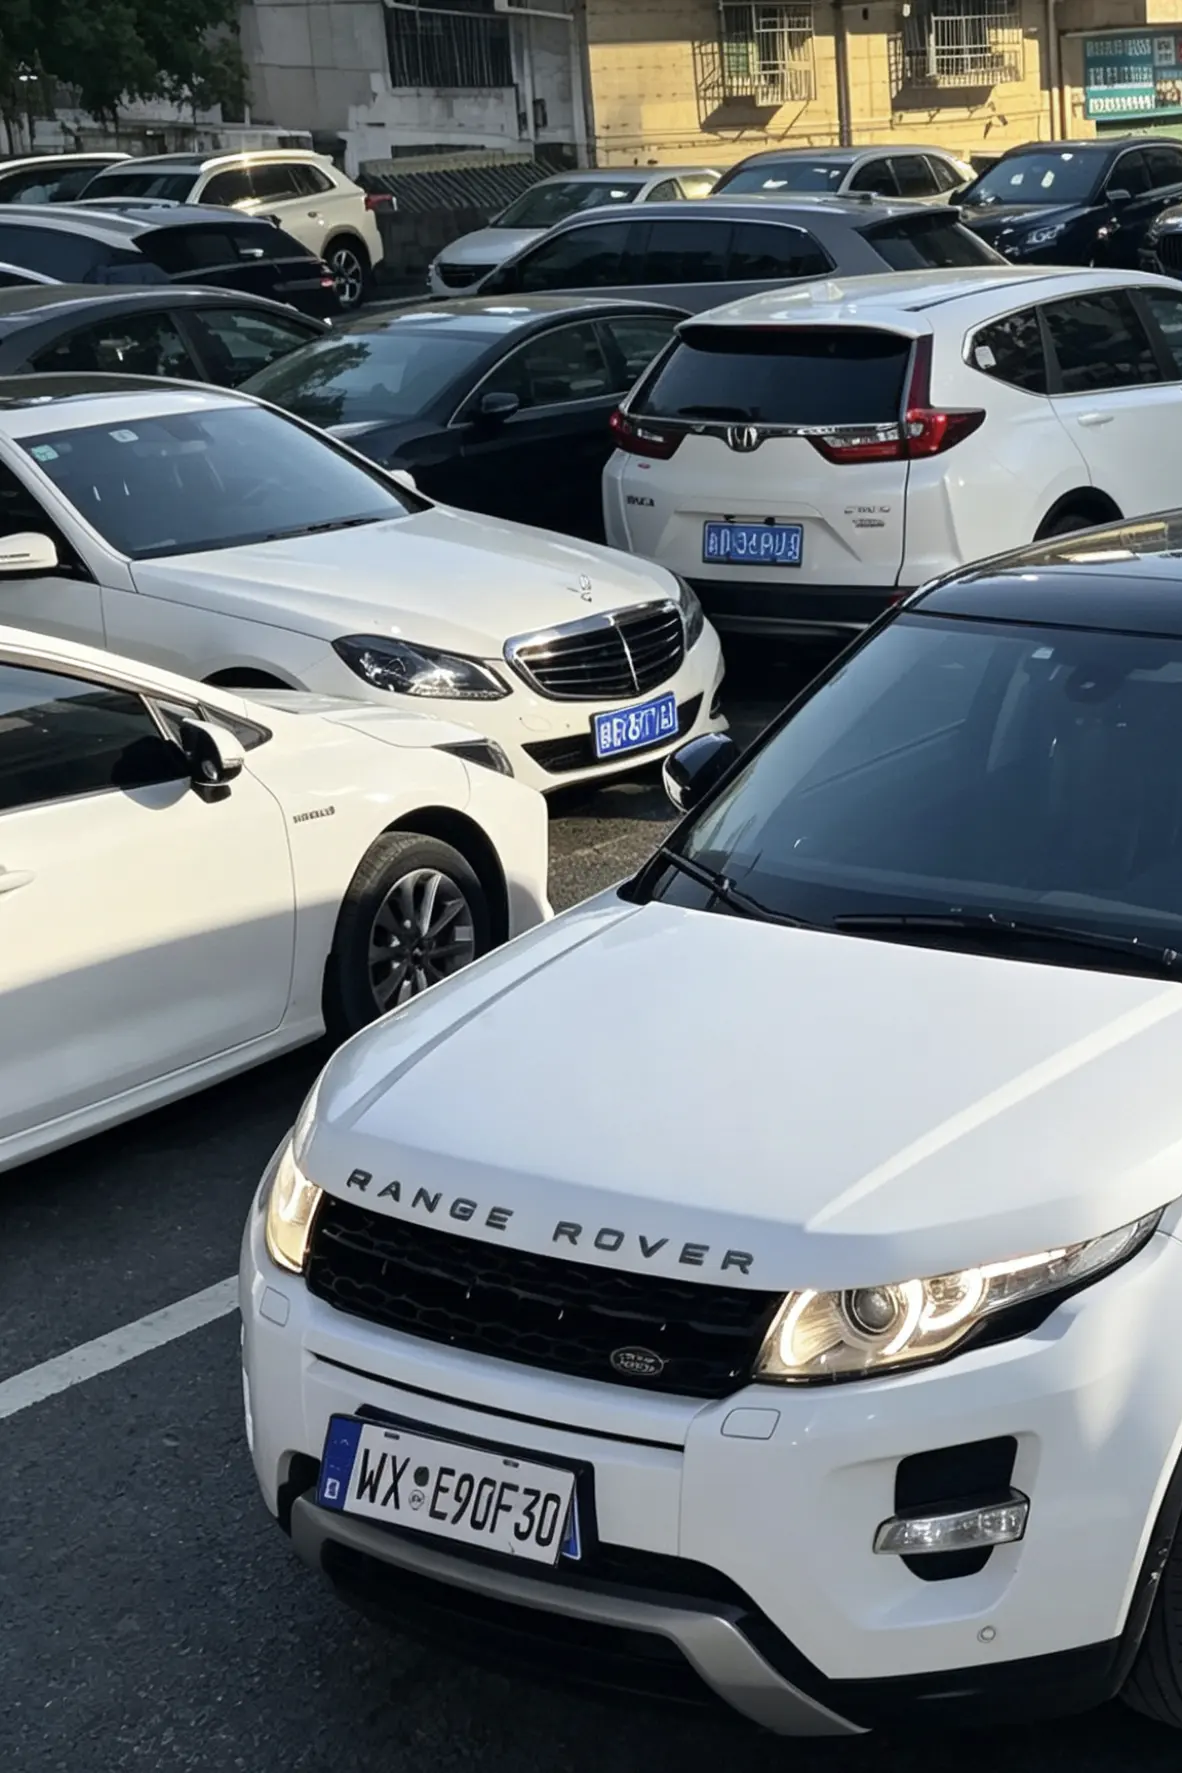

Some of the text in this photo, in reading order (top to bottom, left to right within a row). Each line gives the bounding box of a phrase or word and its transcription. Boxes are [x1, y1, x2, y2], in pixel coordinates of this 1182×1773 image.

[346, 1168, 754, 1275] RANGE ROVER
[356, 1448, 411, 1510] WX
